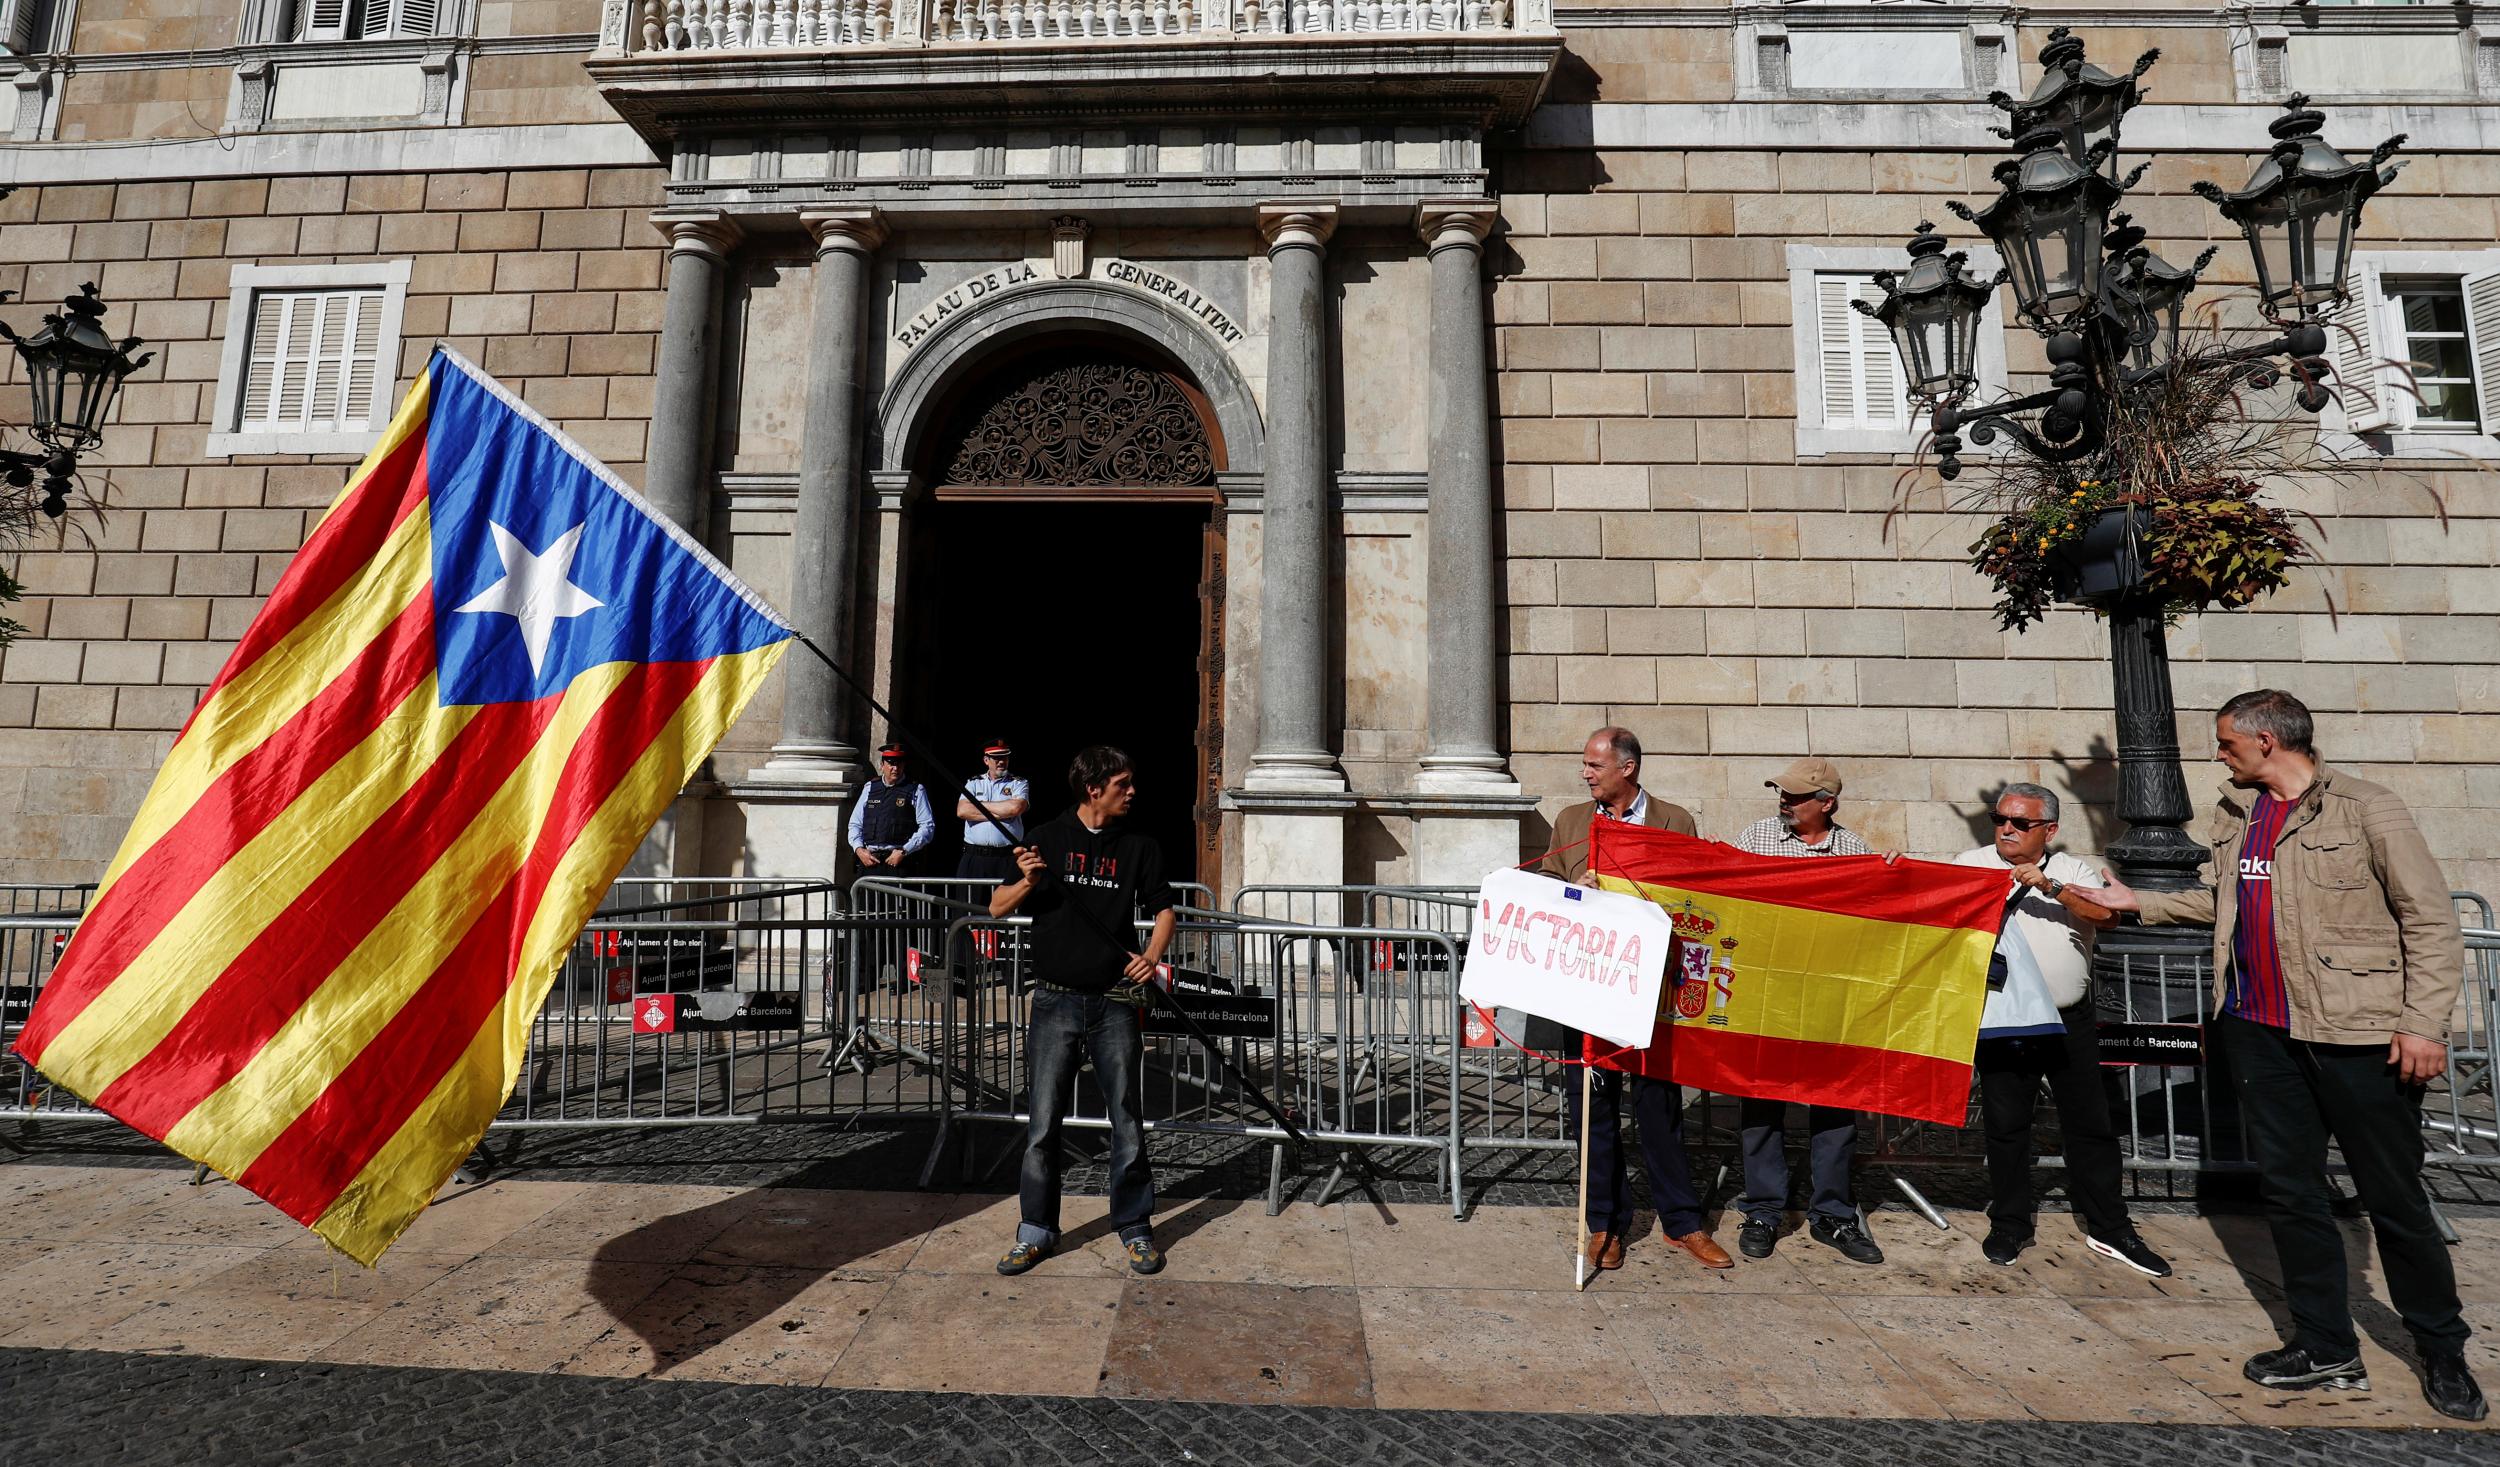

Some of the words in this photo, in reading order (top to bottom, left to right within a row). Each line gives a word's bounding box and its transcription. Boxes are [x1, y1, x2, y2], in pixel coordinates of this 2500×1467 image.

[898, 290, 962, 348] PALAU
[968, 274, 1000, 298] DE
[1005, 263, 1037, 284] LA
[1106, 262, 1243, 342] GENERALITAT
[1090, 876, 1113, 888] hora
[623, 939, 662, 947] Ajutamen
[1482, 899, 1641, 995] VICTORIA
[699, 963, 732, 975] arcelona
[736, 1006, 748, 1016] de
[750, 1006, 793, 1016] Barcelona
[1150, 1007, 1207, 1020] Ajunment
[1208, 1009, 1221, 1020] de
[1222, 1010, 1269, 1023] Barcelona
[2133, 1036, 2145, 1047] de
[2148, 1037, 2198, 1049] Barcelona
